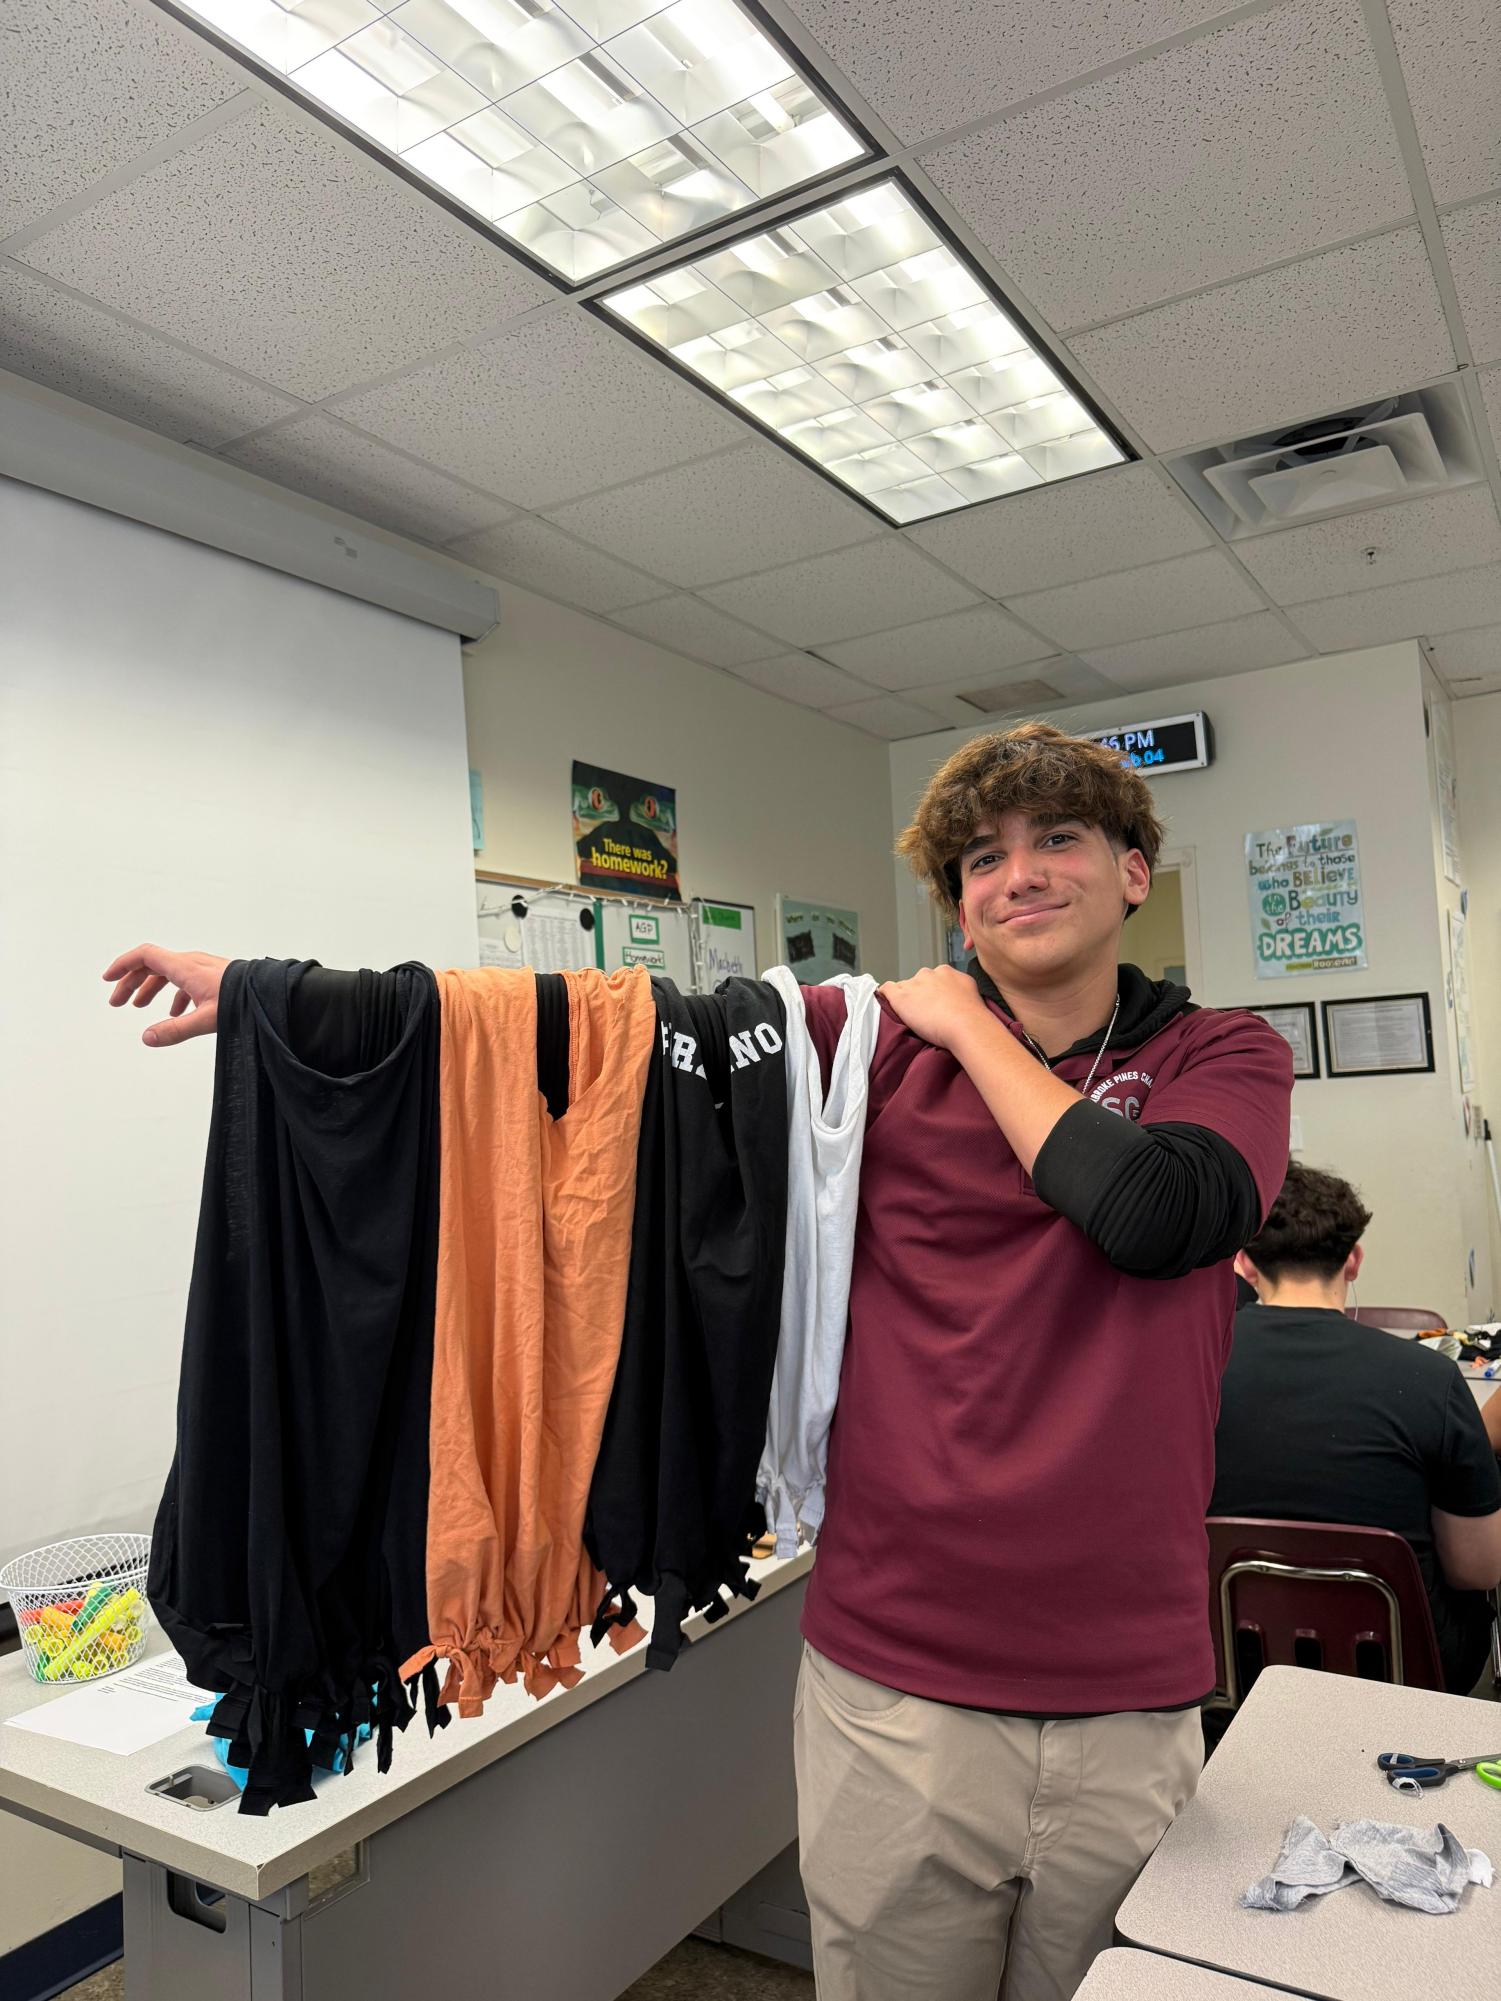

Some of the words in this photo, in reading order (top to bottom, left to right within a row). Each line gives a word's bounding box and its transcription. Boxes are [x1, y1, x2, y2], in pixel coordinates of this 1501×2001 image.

[1124, 730, 1154, 750] PM
[1144, 748, 1164, 765] 04
[603, 838, 631, 857] There
[633, 848, 652, 860] was
[1286, 834, 1353, 858] Future
[591, 846, 668, 880] homework?
[1319, 854, 1356, 867] those
[1258, 876, 1289, 890] who
[1276, 912, 1291, 928] of
[1262, 927, 1358, 957] DREAMS
[1113, 1071, 1138, 1083] PINES
